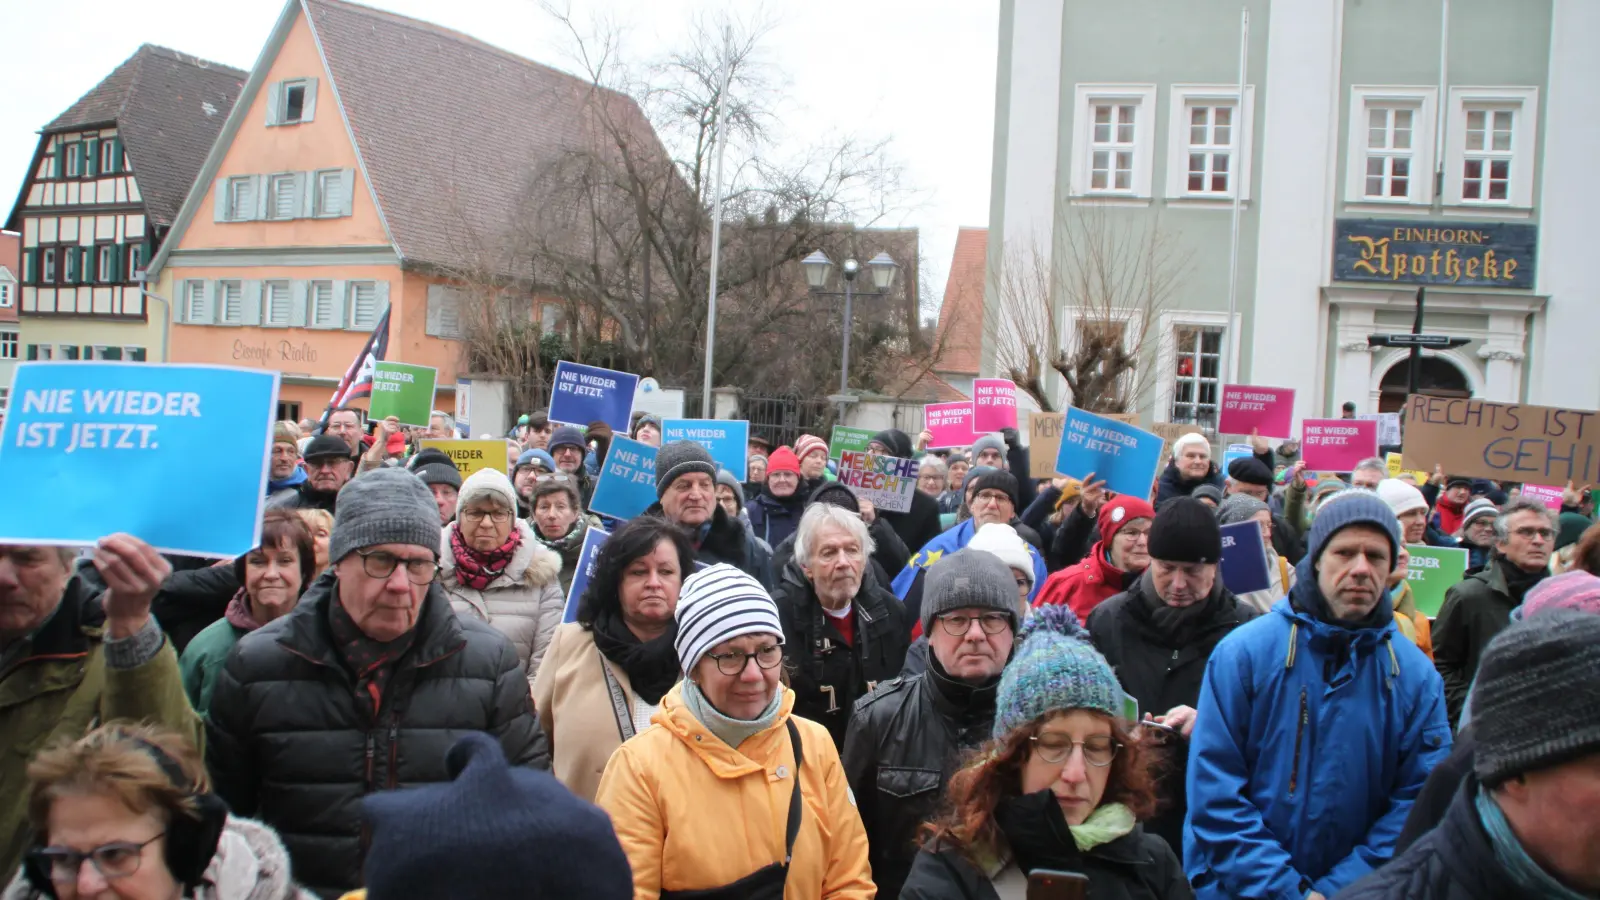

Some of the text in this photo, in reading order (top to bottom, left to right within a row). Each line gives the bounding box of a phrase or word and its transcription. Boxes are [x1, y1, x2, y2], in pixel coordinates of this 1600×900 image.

[1393, 227, 1489, 244] EINHORN-
[1348, 234, 1518, 282] Apotheke
[276, 339, 317, 362] Rialto
[384, 371, 414, 383] WIEDER
[560, 371, 616, 389] NIE WIEDER
[559, 382, 603, 398] IST JETZT.
[1226, 391, 1276, 402] NIE WIEDER
[22, 389, 201, 417] NIE WIEDER
[978, 397, 991, 405] IST
[1225, 401, 1265, 411] IST JETZT.
[943, 408, 972, 416] WIEDER
[1412, 396, 1520, 431] RECHTS
[1542, 409, 1595, 440] IST
[941, 416, 964, 427] JETZT.
[16, 422, 158, 454] IST JETZT.
[667, 428, 726, 438] NIE WIEDER
[1070, 418, 1138, 448] NIE WIEDER
[1306, 426, 1359, 436] NIE WIEDER
[1067, 431, 1121, 456] IST JETZT.
[1306, 436, 1348, 446] IST JETZT.
[615, 449, 640, 466] NIE
[841, 450, 919, 479] MENSCHE
[1483, 436, 1600, 483] GEHI
[610, 463, 632, 478] IST
[838, 469, 912, 494] NRECHT
[1409, 556, 1440, 568] EDER
